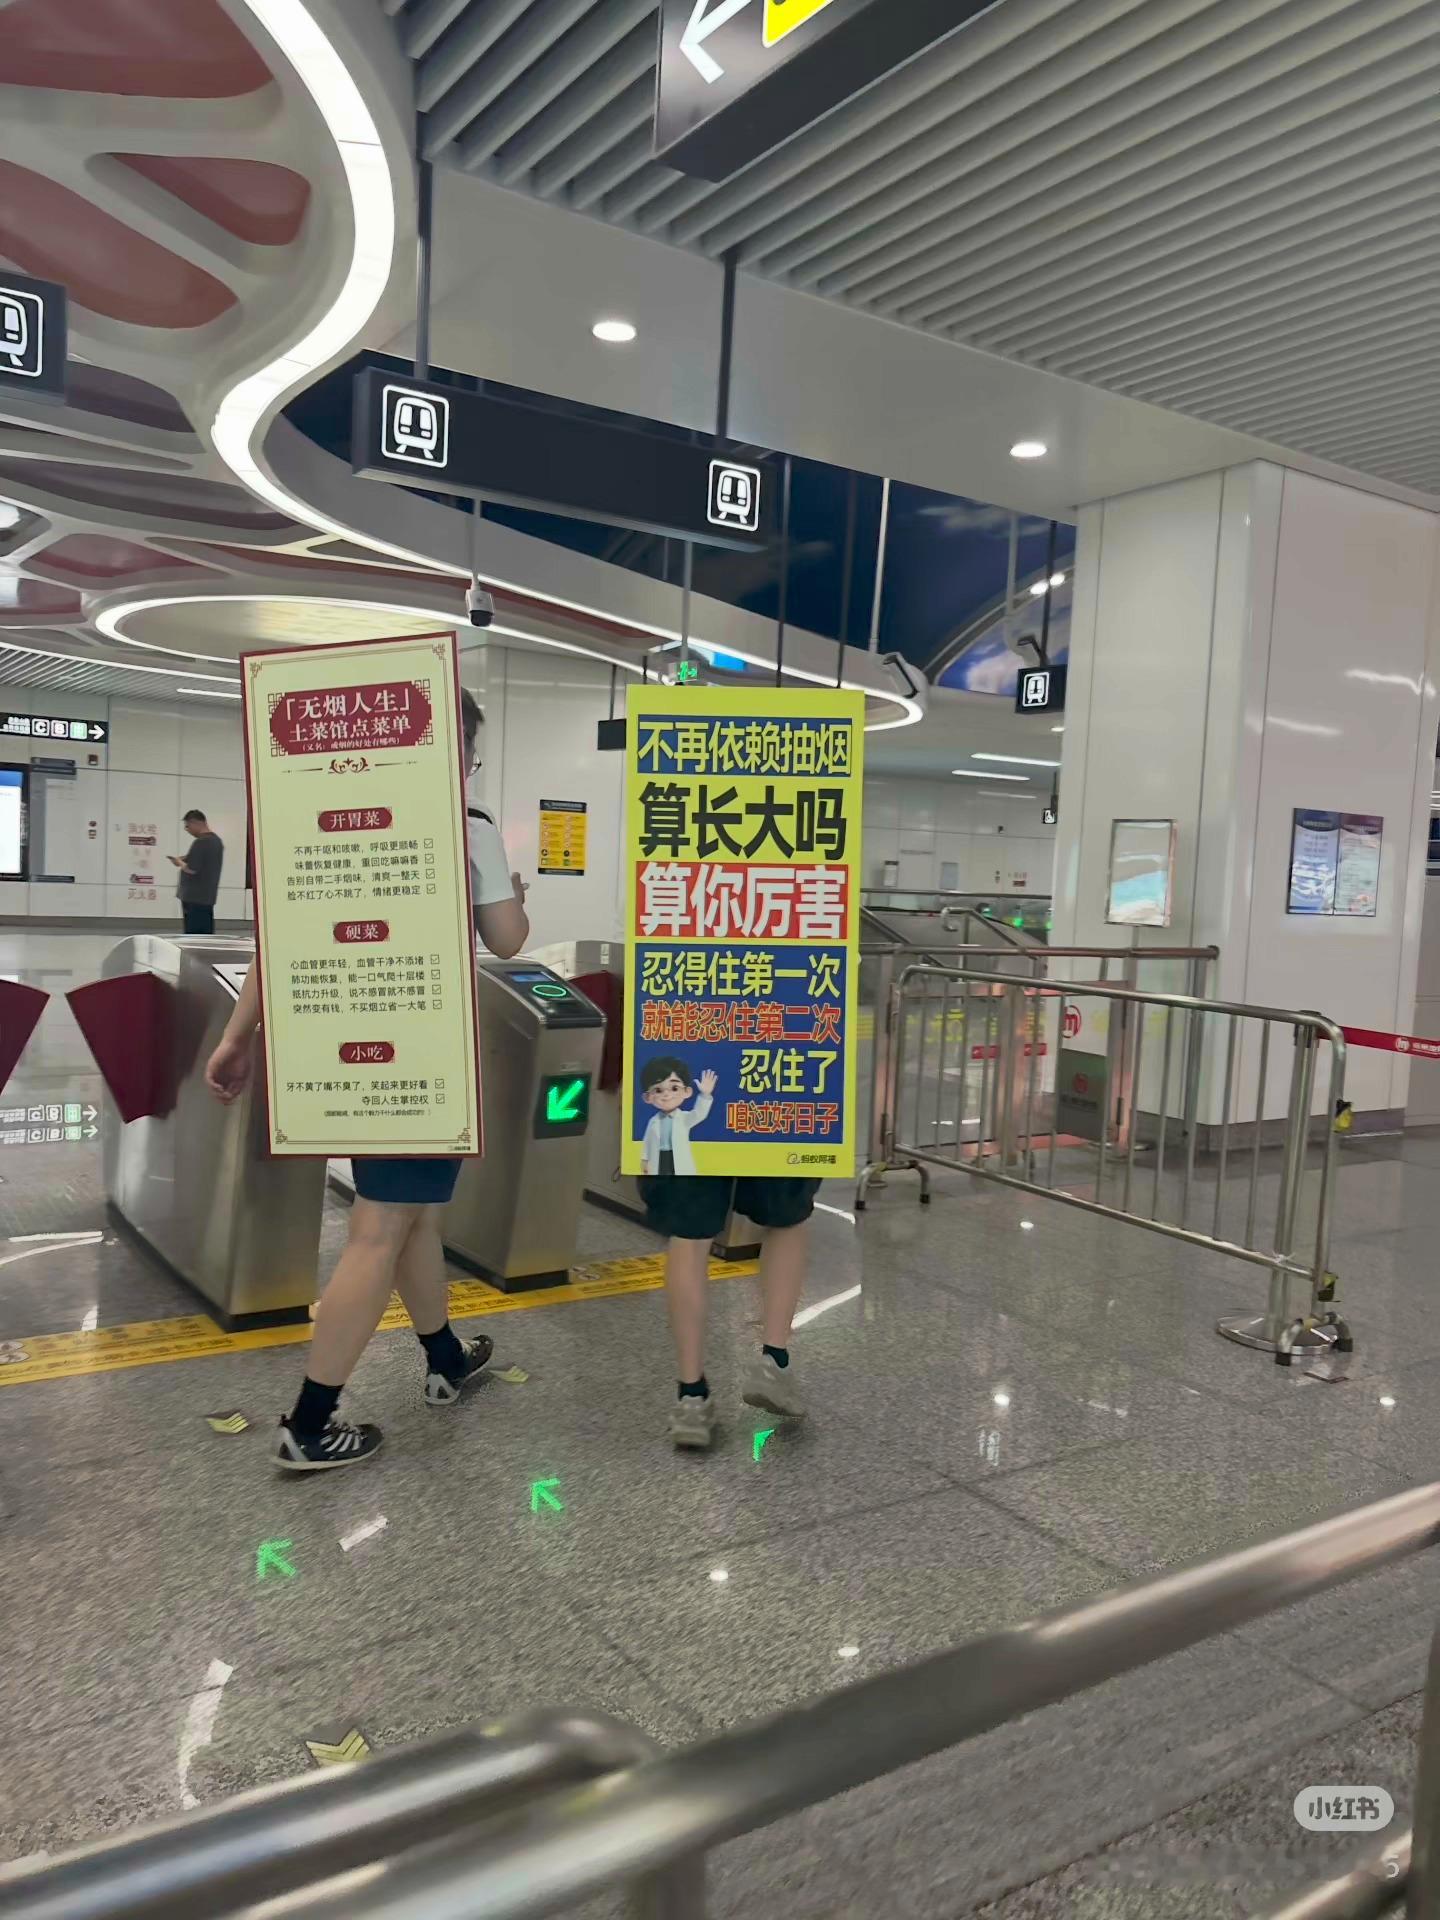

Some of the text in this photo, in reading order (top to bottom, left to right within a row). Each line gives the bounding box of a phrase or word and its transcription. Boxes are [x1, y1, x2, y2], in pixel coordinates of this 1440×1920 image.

[285, 688, 412, 721] 「无烟人生」
[288, 716, 412, 744] 土菜馆点菜单
[638, 720, 852, 775] 不再依赖抽烟
[329, 811, 381, 829] 开胃菜
[638, 782, 847, 861] 算长大吗
[639, 861, 846, 939] 算你厉害
[345, 923, 380, 941] 硬菜
[641, 950, 841, 998] 忍得住第一次
[640, 1000, 842, 1044] 就能忍住第二次
[350, 1045, 384, 1062] 小吃
[738, 1047, 837, 1094] 忍住了
[361, 1095, 430, 1106] 夺回人生掌控权
[726, 1100, 839, 1135] 咱过好日子
